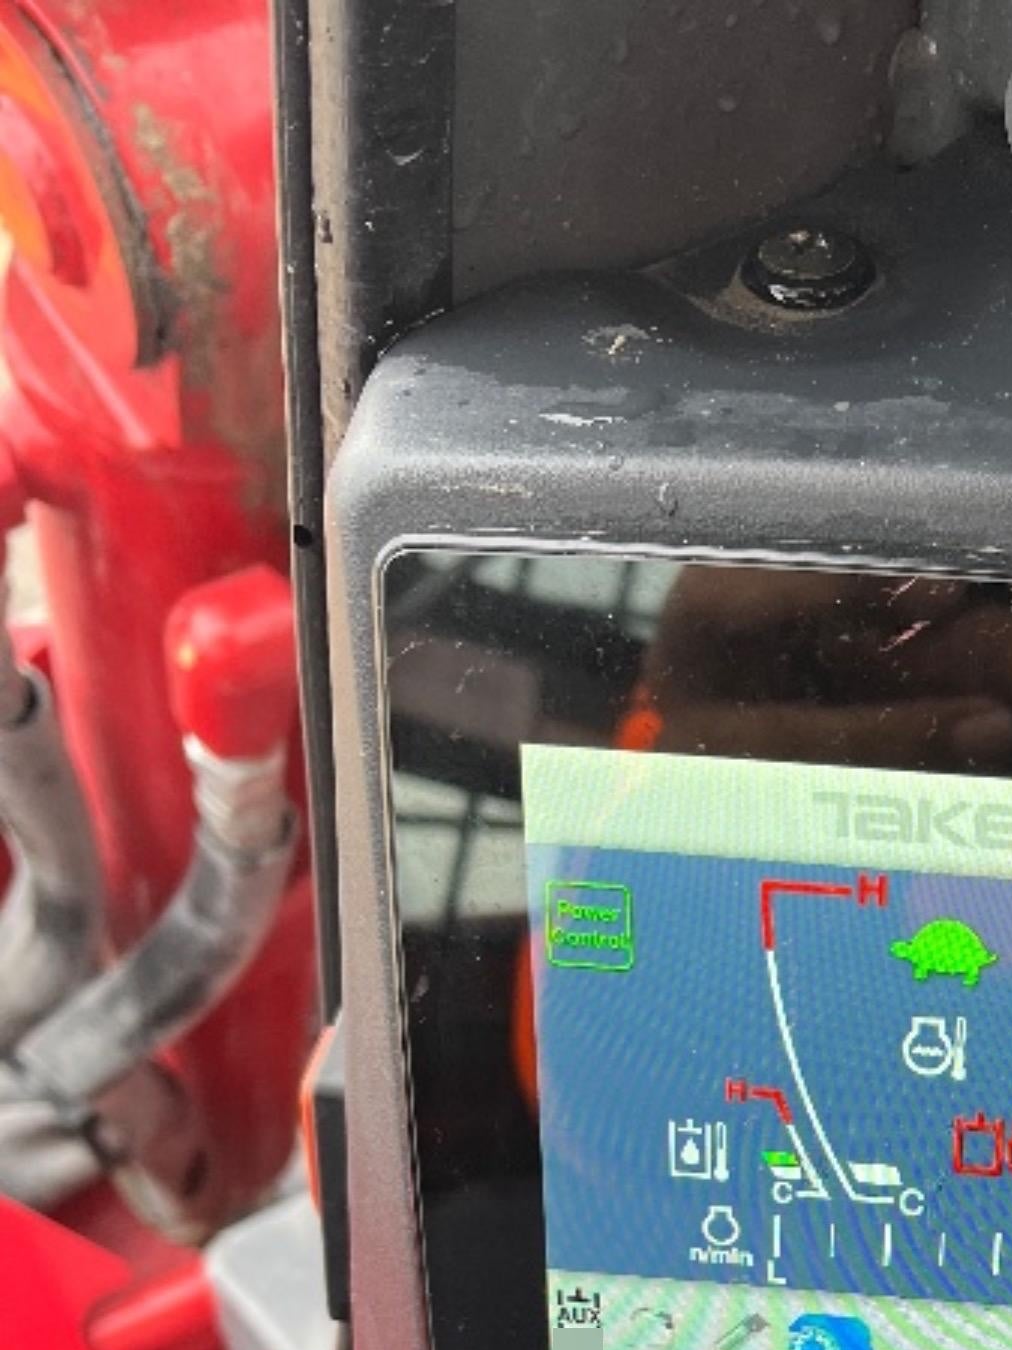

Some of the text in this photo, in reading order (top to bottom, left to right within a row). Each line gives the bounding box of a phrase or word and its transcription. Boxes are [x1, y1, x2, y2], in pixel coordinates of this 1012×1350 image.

[857, 873, 889, 908] H
[725, 1078, 748, 1103] H
[773, 1181, 793, 1204] C
[900, 1188, 925, 1216] C
[767, 1260, 787, 1285] L
[557, 1307, 601, 1323] AUX
